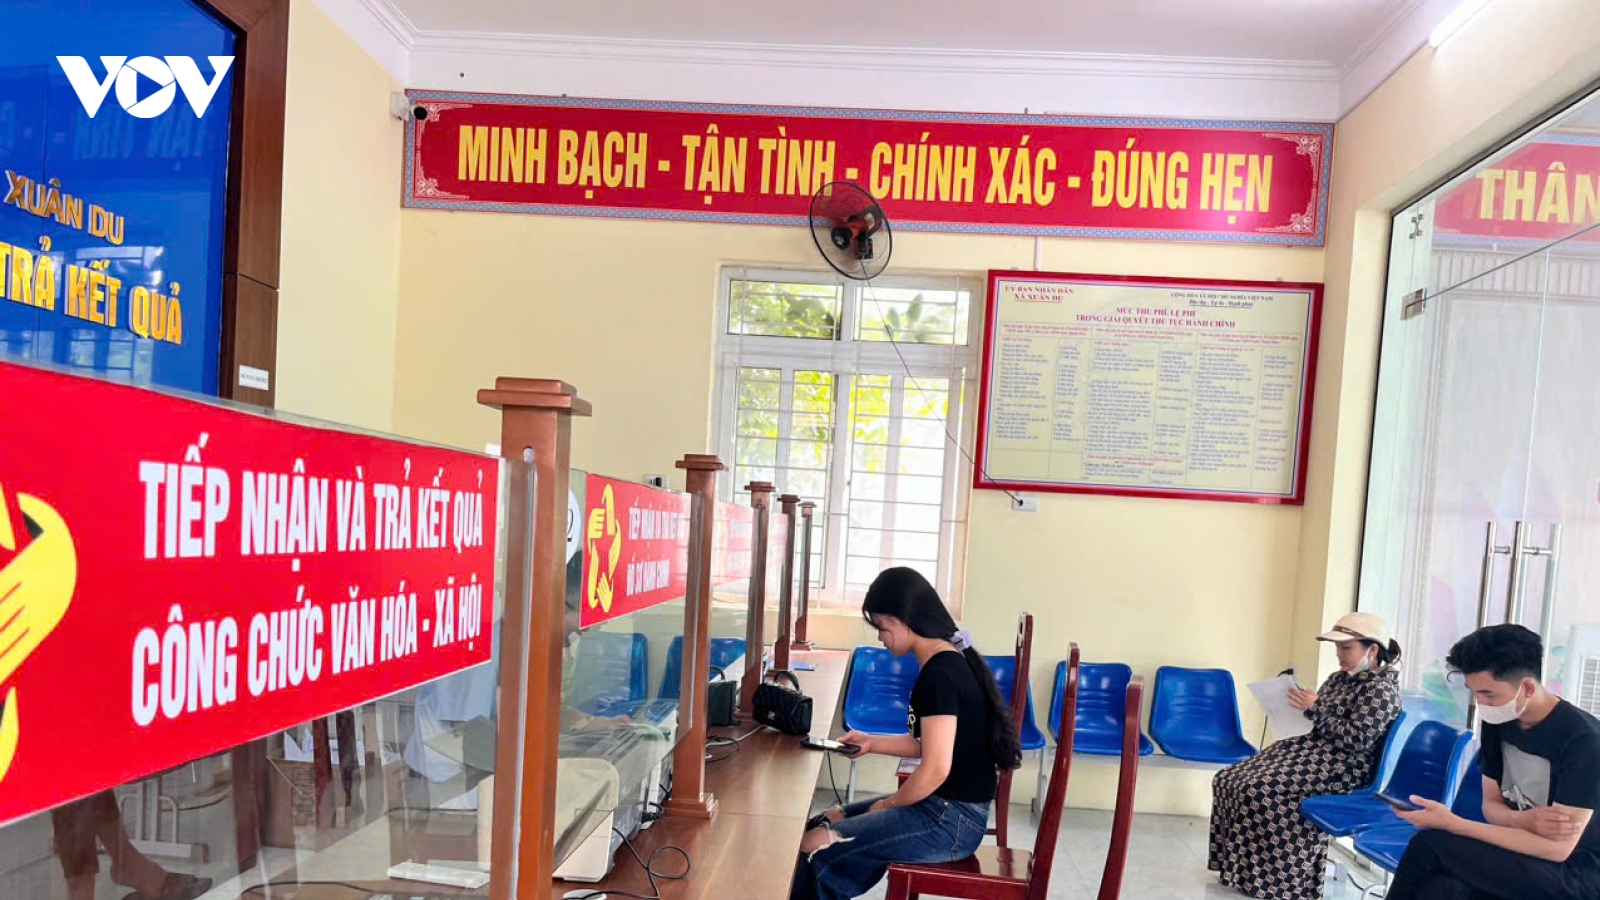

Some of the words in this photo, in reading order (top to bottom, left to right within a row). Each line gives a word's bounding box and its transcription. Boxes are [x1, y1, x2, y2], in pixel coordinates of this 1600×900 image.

[5, 170, 83, 230] XUÂN
[87, 204, 125, 245] DU
[458, 125, 548, 184] MINH
[557, 129, 648, 198] BẠCH
[658, 159, 670, 171] -
[682, 123, 748, 205] TẬN
[759, 126, 836, 197] TÌNH
[845, 168, 858, 179] -
[869, 131, 977, 203] CHÍNH
[985, 135, 1057, 207] XÁC
[1068, 176, 1080, 188] -
[1091, 139, 1189, 209] ĐÚNG
[1200, 152, 1274, 225] HẸN
[0, 236, 55, 311] TRẢ
[64, 260, 121, 328] KẾT
[129, 281, 182, 345] QUẢ
[139, 432, 231, 559] TIẾP
[241, 458, 329, 572] NHẬN
[336, 465, 366, 552] VÀ
[374, 458, 411, 550] TRẢ
[416, 468, 450, 549] KẾT
[453, 469, 484, 553] QUẢ
[131, 603, 239, 727] CÔNG
[247, 585, 324, 697] CHỨC
[331, 586, 376, 675] VĂN
[380, 580, 418, 662] HÓA
[422, 615, 430, 632] -
[433, 577, 455, 648] XÃ
[457, 573, 483, 652] HỘI
